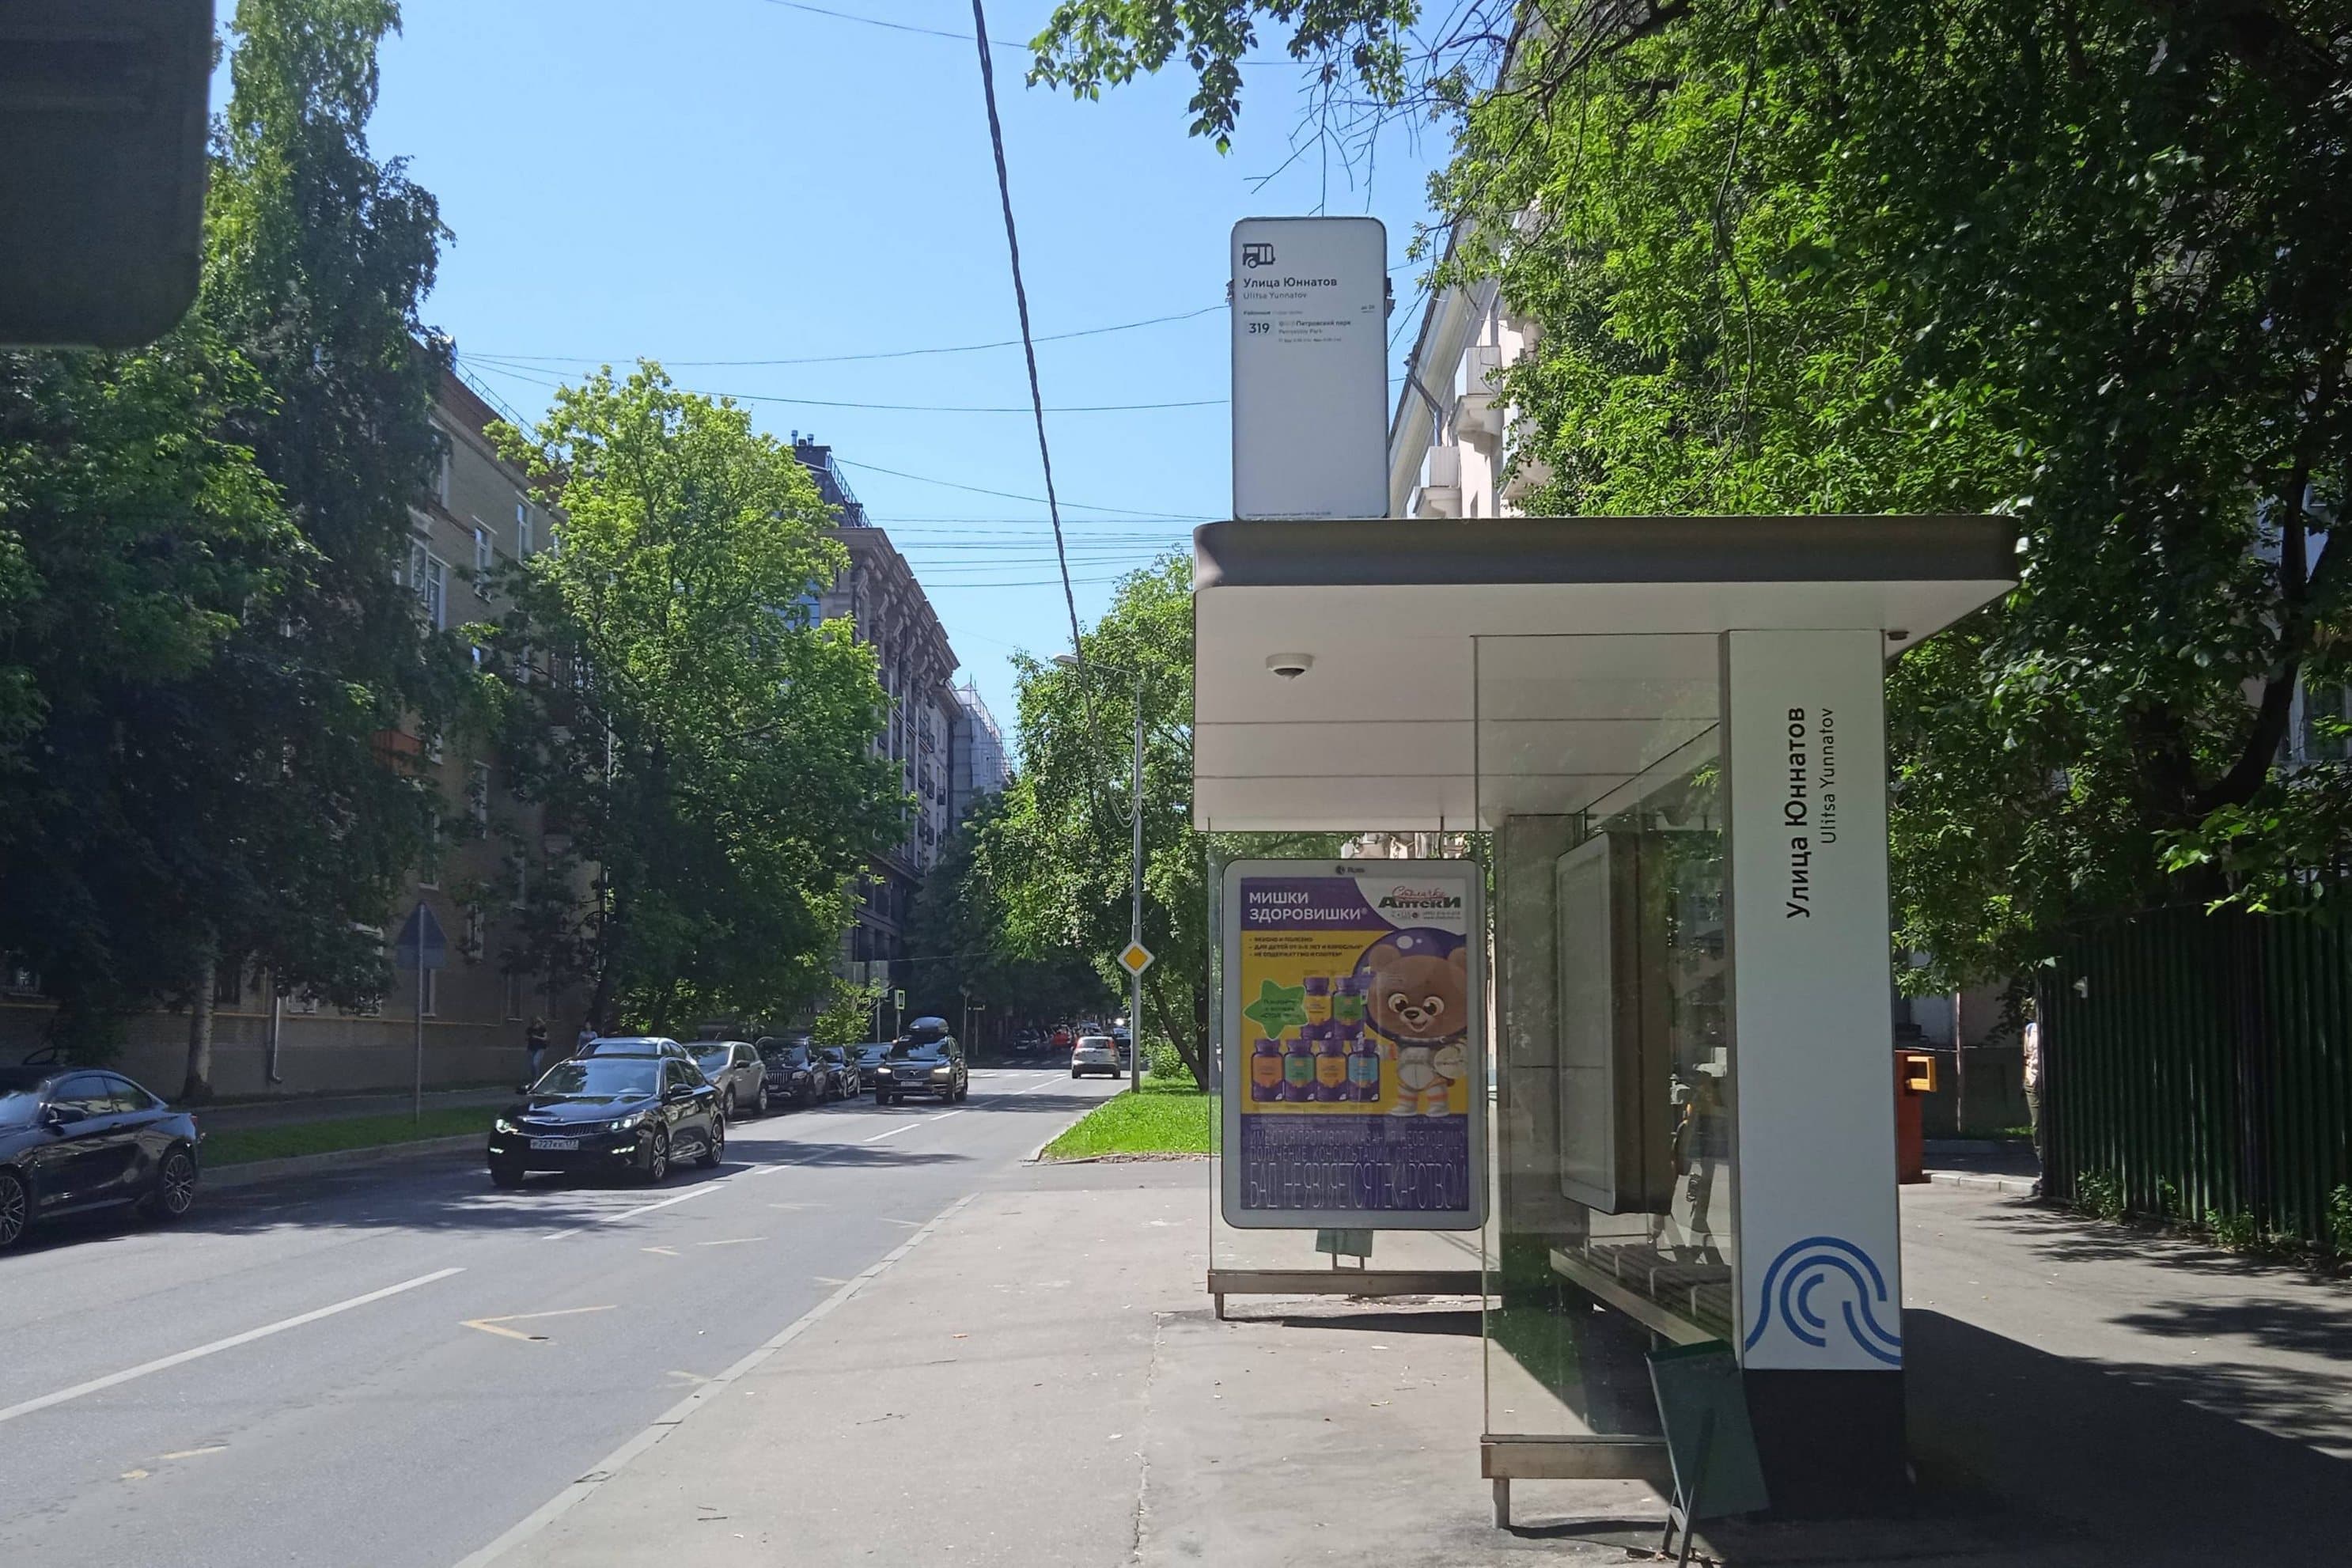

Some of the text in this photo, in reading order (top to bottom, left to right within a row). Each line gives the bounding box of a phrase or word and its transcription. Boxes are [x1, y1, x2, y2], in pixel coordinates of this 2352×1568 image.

[1244, 277, 1338, 289] Улица Юннатов
[1248, 322, 1271, 334] 319
[1819, 708, 1836, 844] Ulitsa Yunnatov
[1784, 707, 1812, 918] Улица Юннатов
[1249, 892, 1309, 904] МИШКИ
[1249, 908, 1362, 923] ЗДОРОВИШКИ
